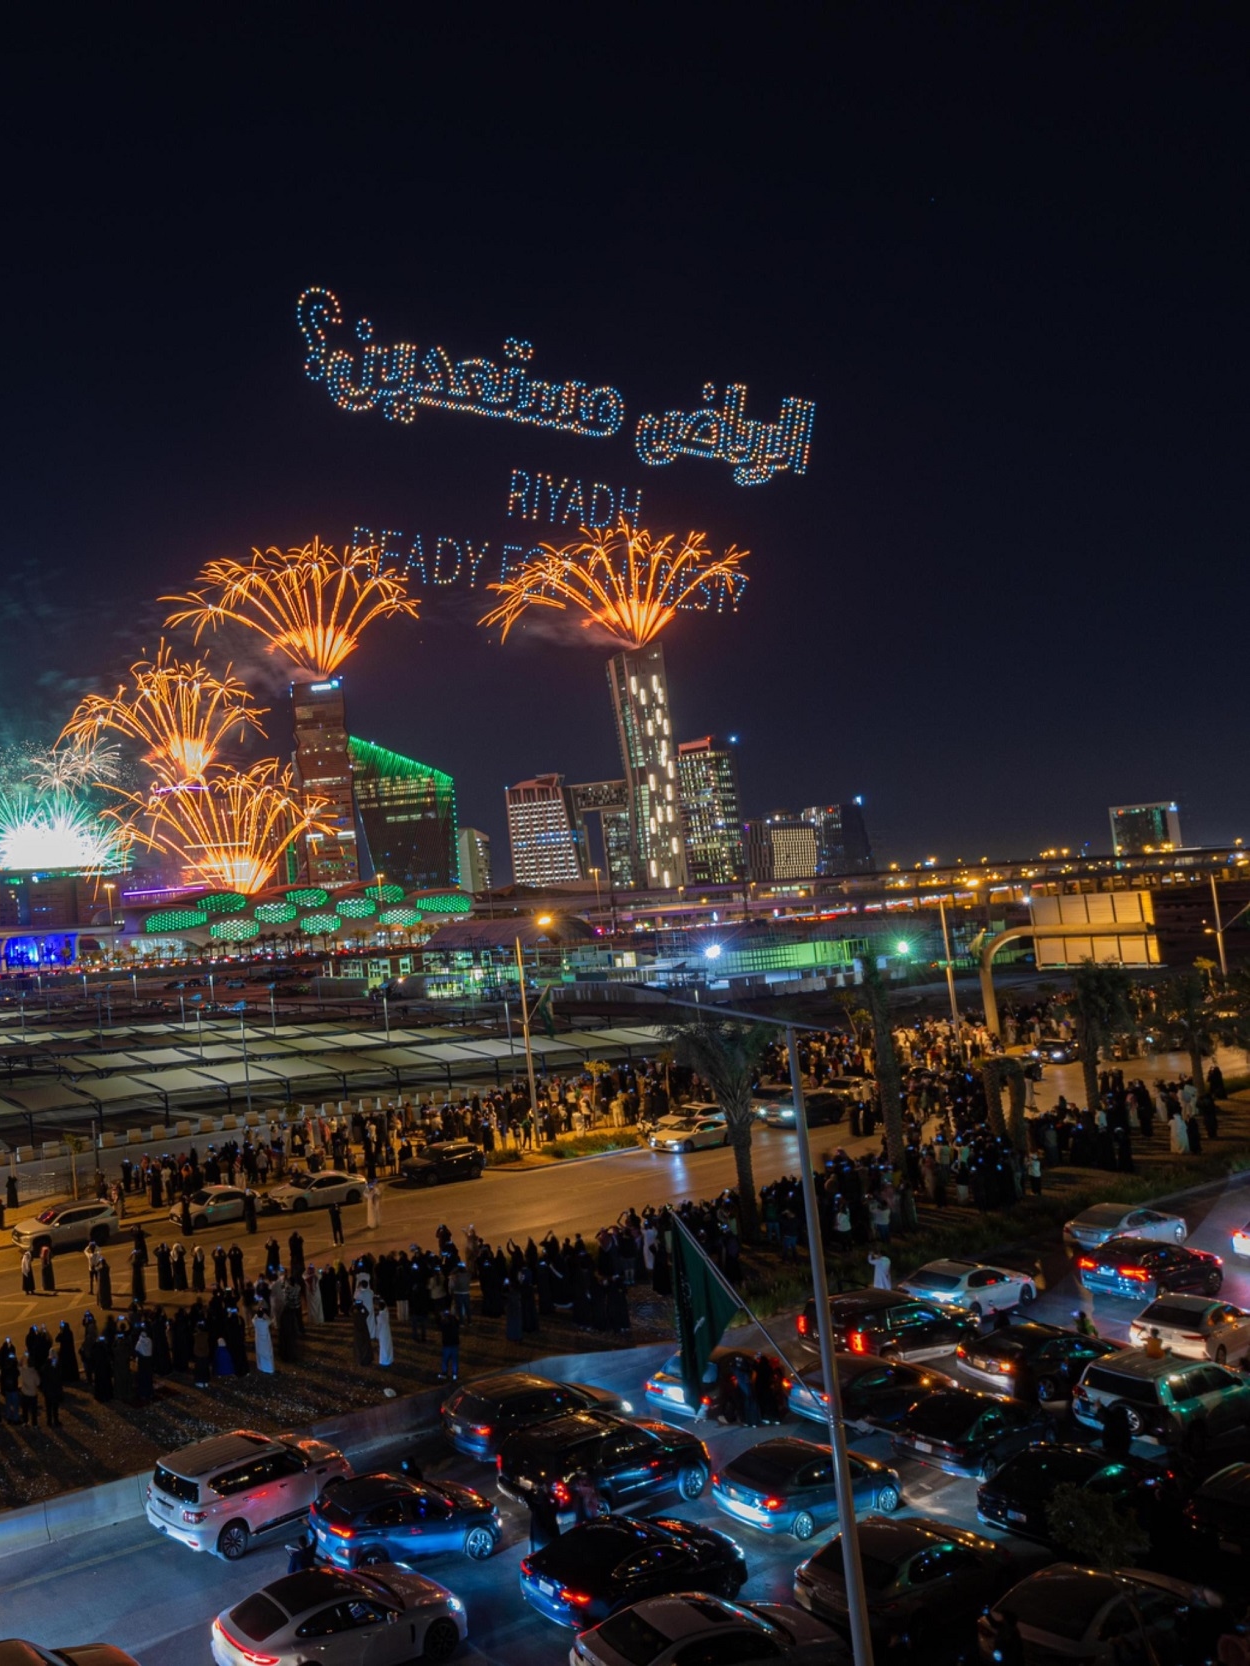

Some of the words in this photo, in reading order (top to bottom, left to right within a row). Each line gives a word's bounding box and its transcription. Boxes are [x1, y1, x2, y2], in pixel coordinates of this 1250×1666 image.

[635, 382, 816, 486] الرياض
[508, 469, 642, 533] RIYADH
[352, 526, 489, 588] READY
